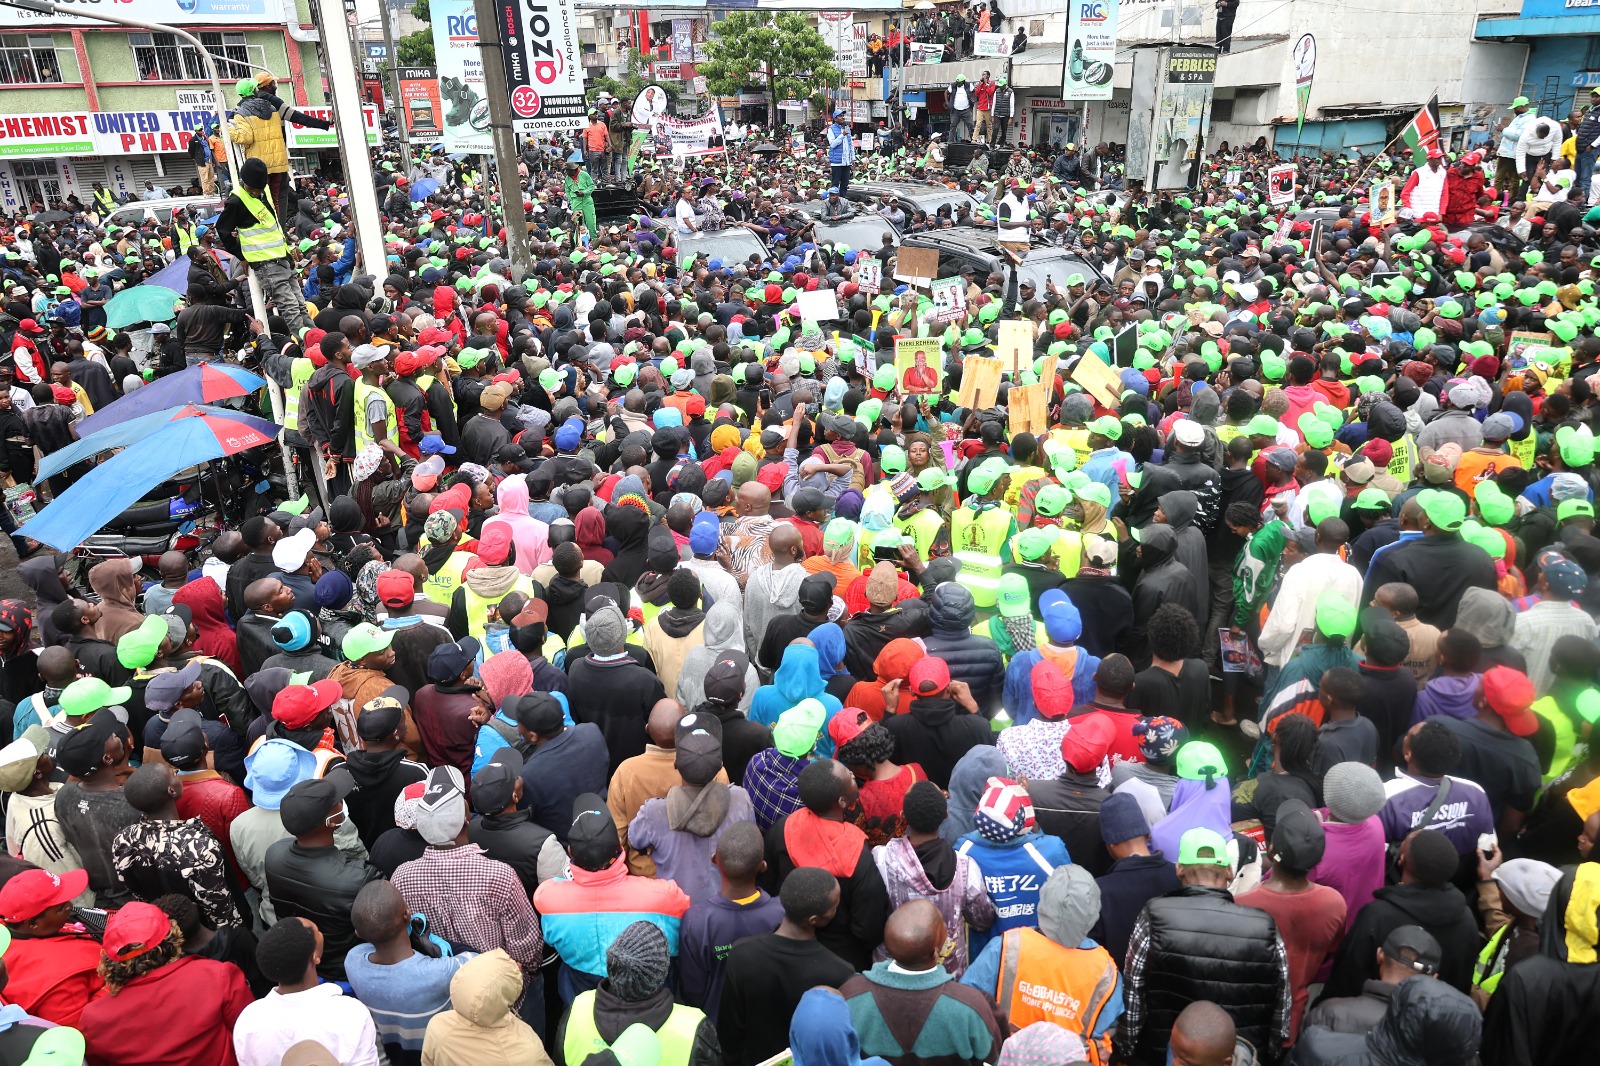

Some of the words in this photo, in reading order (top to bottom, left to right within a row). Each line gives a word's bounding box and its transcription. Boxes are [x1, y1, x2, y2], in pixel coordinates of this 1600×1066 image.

[211, 3, 250, 12] warranty
[506, 5, 516, 34] BOSCH
[562, 9, 574, 61] Appliance
[511, 52, 523, 80] MIKA
[1170, 59, 1216, 71] PEBBLES
[406, 69, 431, 78] MIKA
[464, 69, 478, 77] just
[1188, 73, 1203, 81] SPA
[515, 91, 537, 107] 32
[544, 97, 582, 106] SHOWROOMS
[543, 105, 586, 115] COUNTRYWIDE
[94, 112, 160, 134] UNITED
[523, 118, 581, 129] azone.co.ke
[1018, 980, 1081, 1012] GLOBALSTAR
[1021, 994, 1042, 1008] HOME
